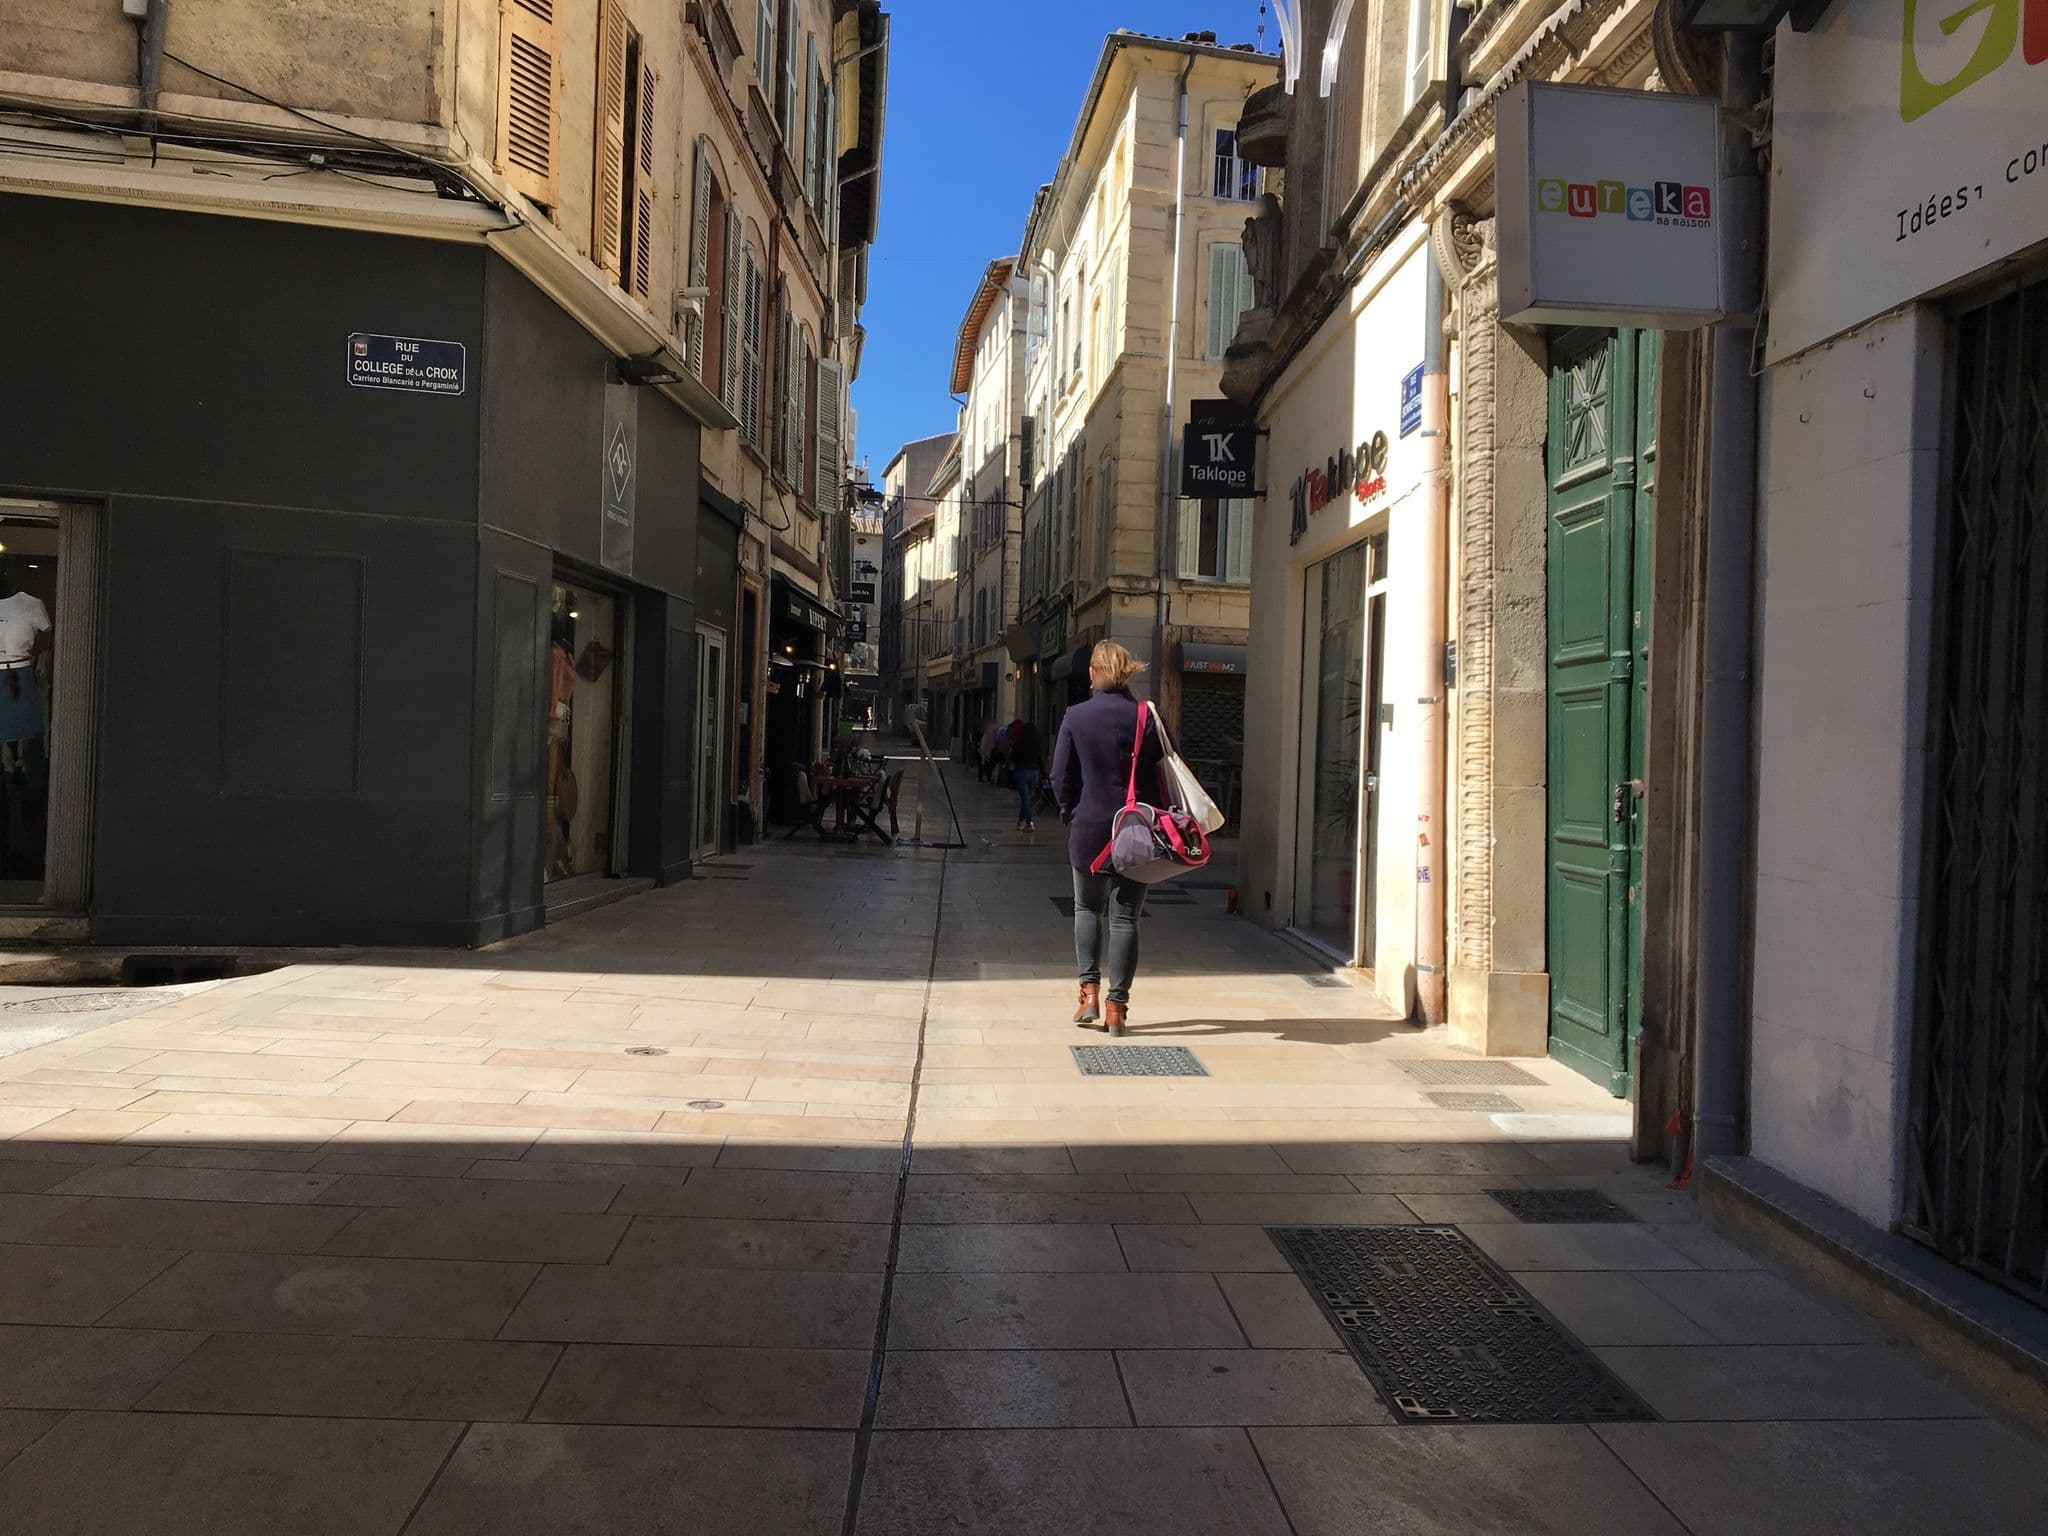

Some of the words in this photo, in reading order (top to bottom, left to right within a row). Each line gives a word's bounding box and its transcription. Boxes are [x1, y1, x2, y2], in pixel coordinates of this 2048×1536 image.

[1540, 180, 1709, 220] eureka
[1656, 217, 1670, 226] ma
[1672, 218, 1711, 228] maison
[395, 342, 419, 353] RUE
[401, 354, 413, 362] DU
[354, 360, 404, 375] COLLEGE
[426, 366, 458, 380] CROIX
[352, 373, 381, 384] Carriero
[1201, 432, 1235, 462] TK
[1189, 464, 1246, 485] Taklope
